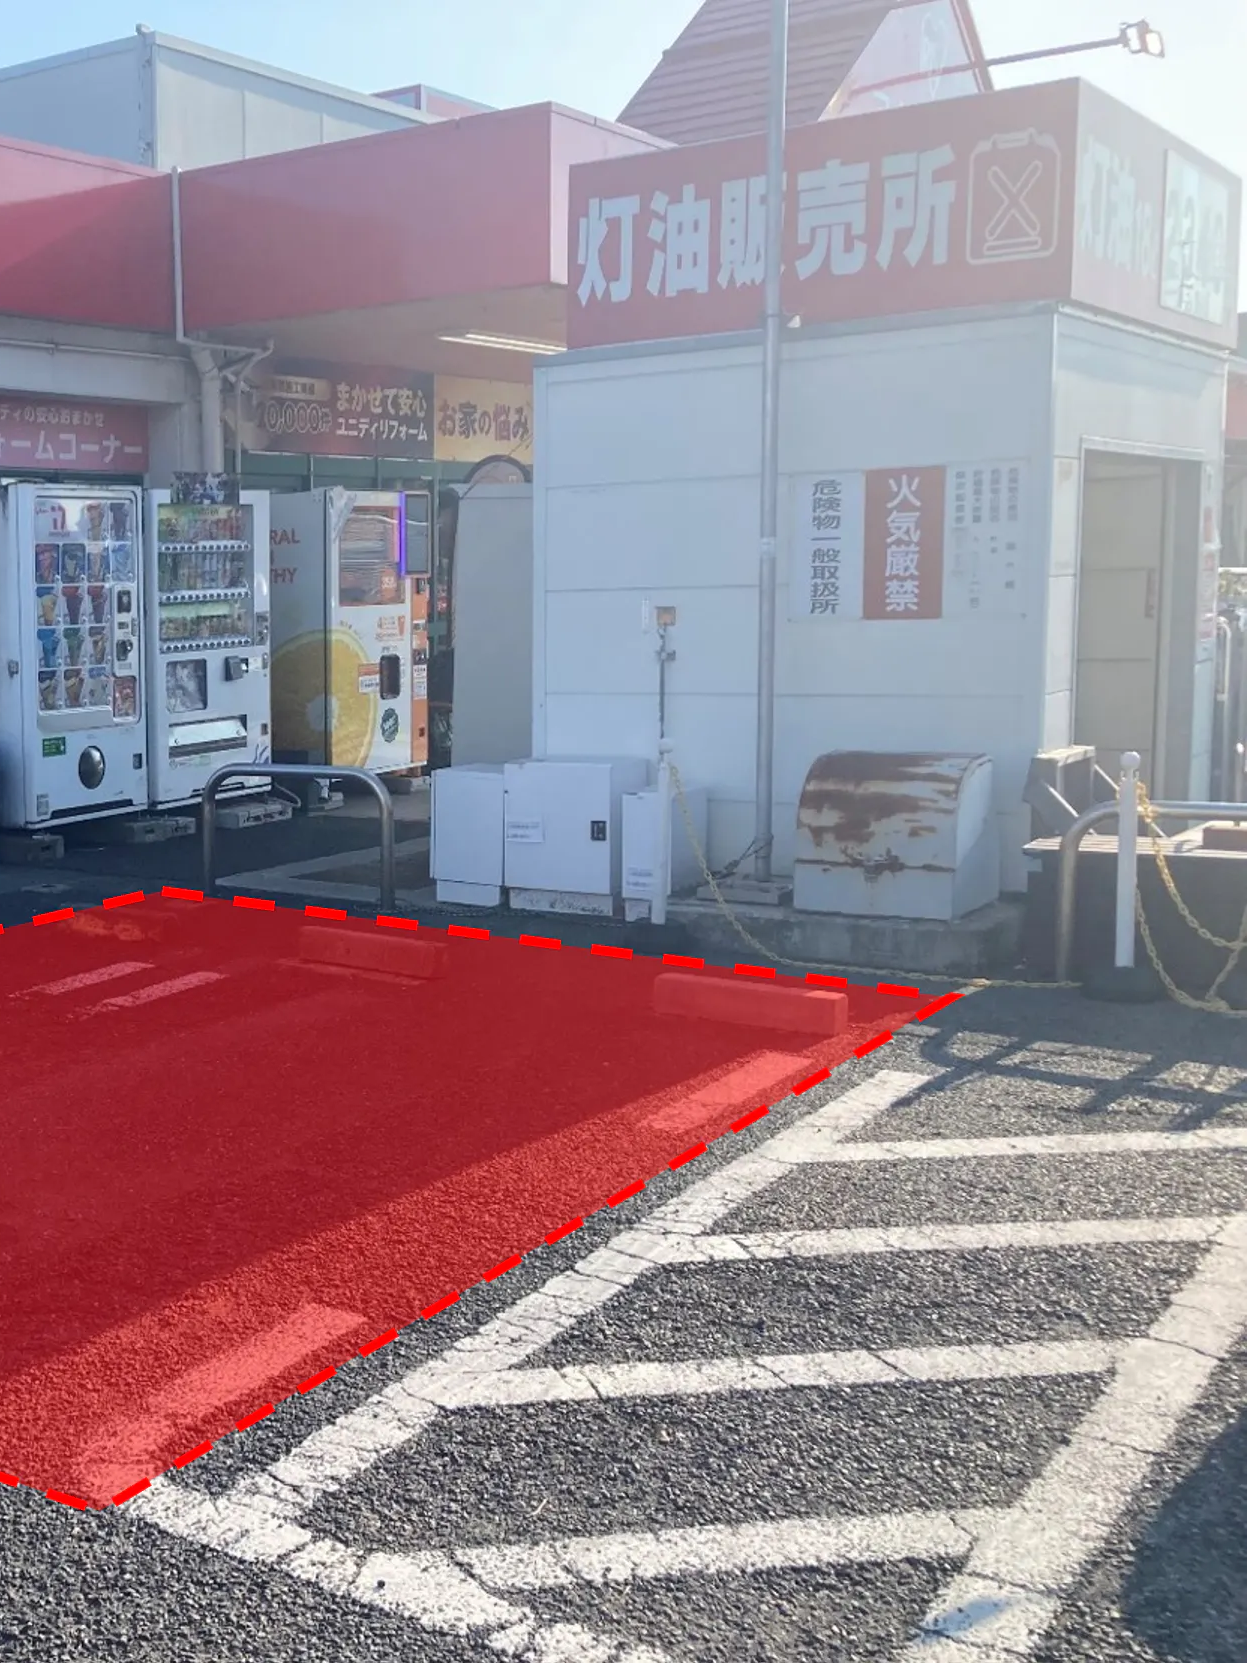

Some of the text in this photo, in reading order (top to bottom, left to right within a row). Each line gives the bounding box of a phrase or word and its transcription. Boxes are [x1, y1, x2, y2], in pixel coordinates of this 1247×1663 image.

[576, 144, 957, 308] 灯油販売所
[336, 381, 428, 416] まかせて安心
[336, 417, 428, 442] ユニティリフォーム
[809, 478, 843, 615] 危険物一般取扱所
[884, 473, 922, 613] 火気厳禁
